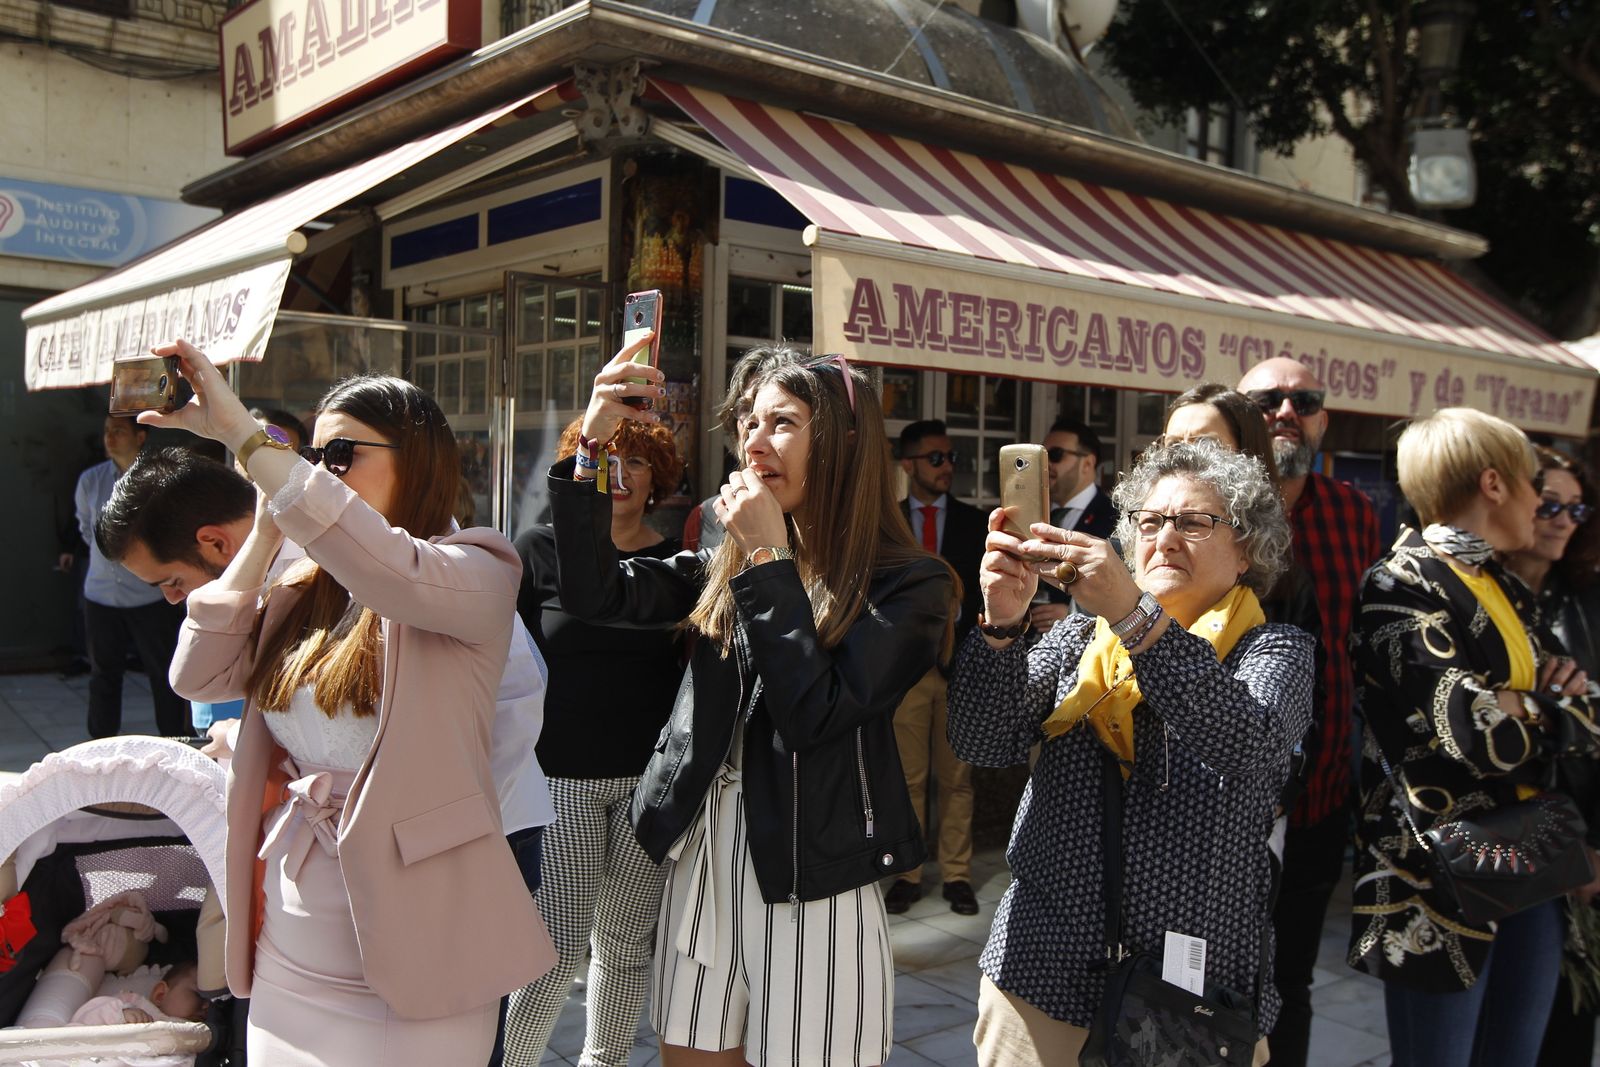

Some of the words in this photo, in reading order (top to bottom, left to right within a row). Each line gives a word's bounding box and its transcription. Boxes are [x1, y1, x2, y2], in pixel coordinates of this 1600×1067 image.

[36, 199, 120, 220] INSTITUTO
[36, 214, 120, 236] AUDITIVO
[36, 229, 118, 251] INTEGRAL
[98, 287, 250, 365] AMERICANOS
[843, 278, 1207, 380] AMERICANOS
[1409, 371, 1427, 416] y
[1434, 368, 1464, 409] de
